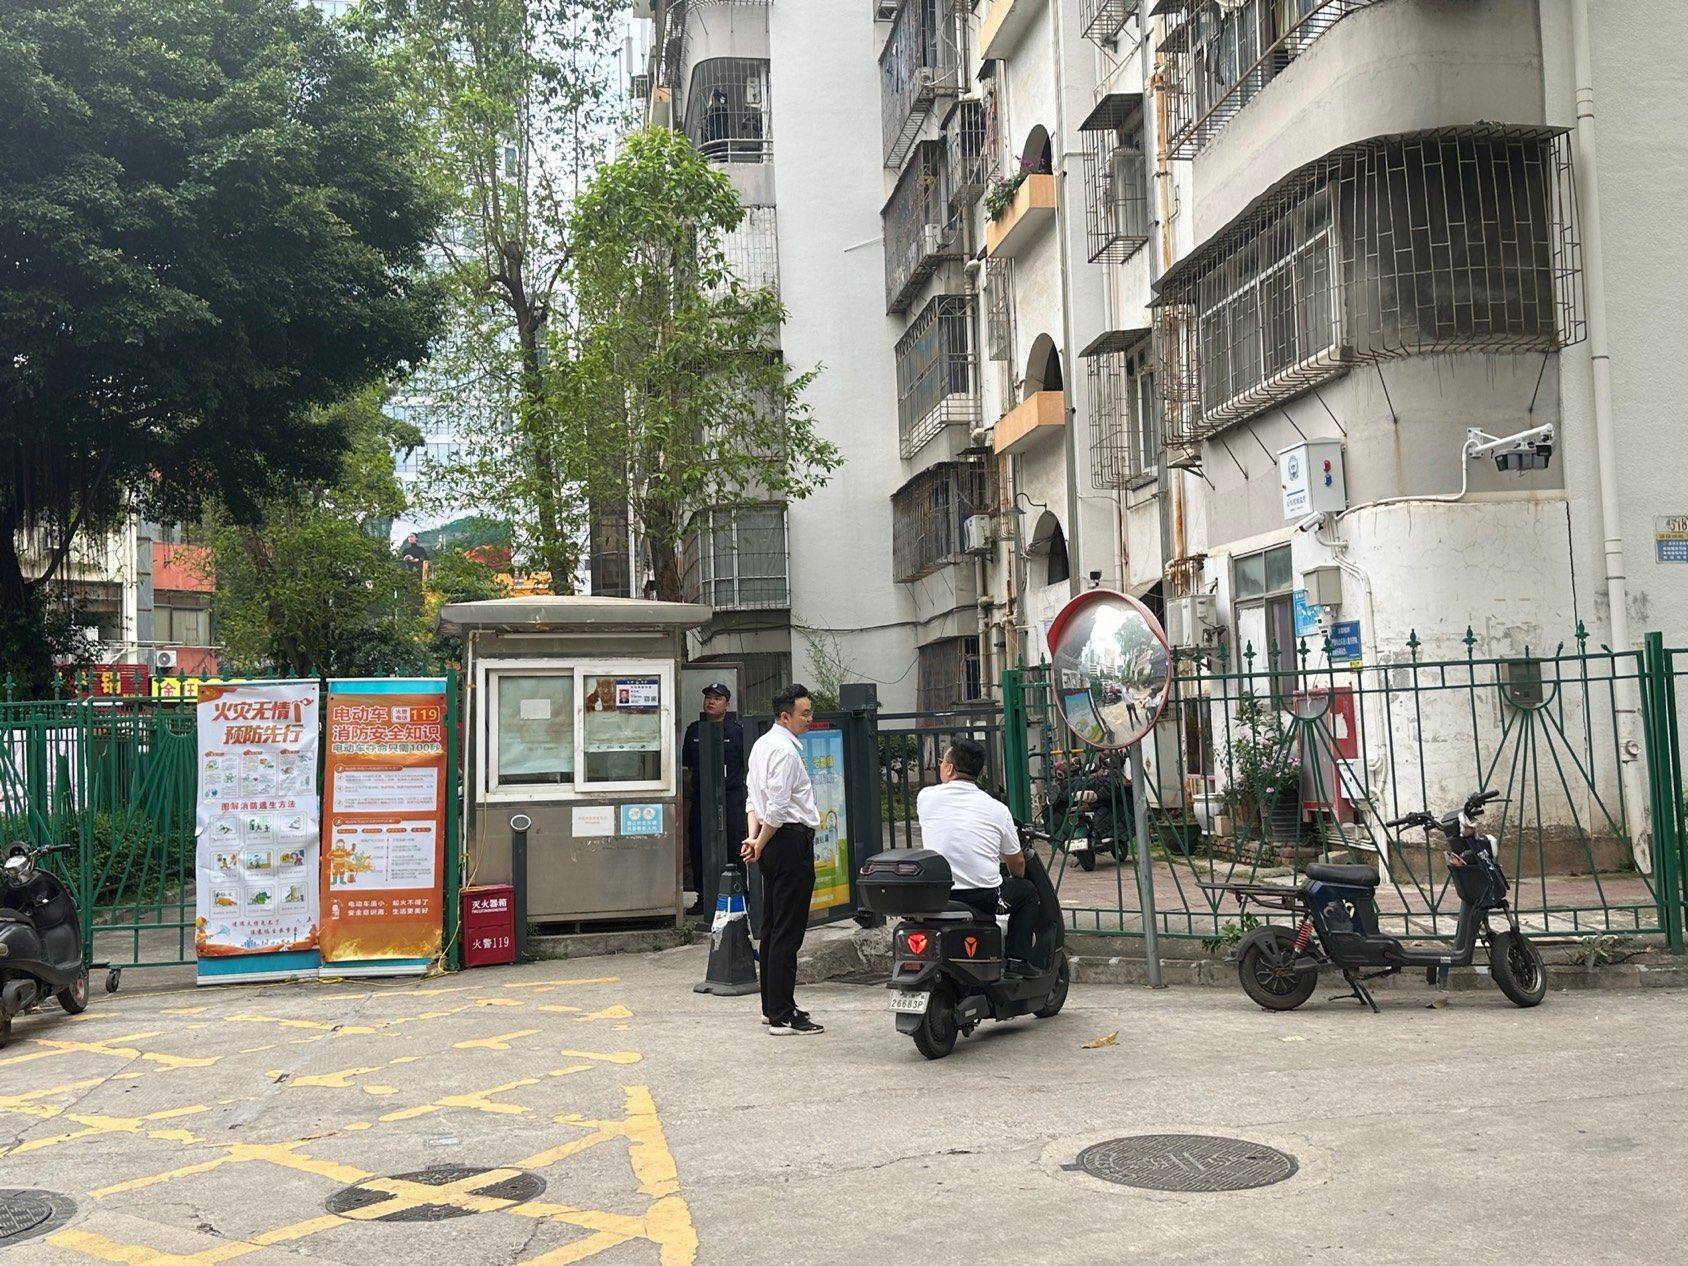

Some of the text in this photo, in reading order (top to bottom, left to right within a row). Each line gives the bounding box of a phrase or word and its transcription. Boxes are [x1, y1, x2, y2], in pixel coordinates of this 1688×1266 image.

[212, 701, 290, 721] 火灾无情
[333, 705, 388, 722] 电动车
[411, 709, 437, 721] 119
[223, 724, 303, 745] 预防先行
[333, 725, 441, 741] 消防安全知识
[472, 898, 507, 909] 灭火器箱
[472, 937, 509, 949] 火警119
